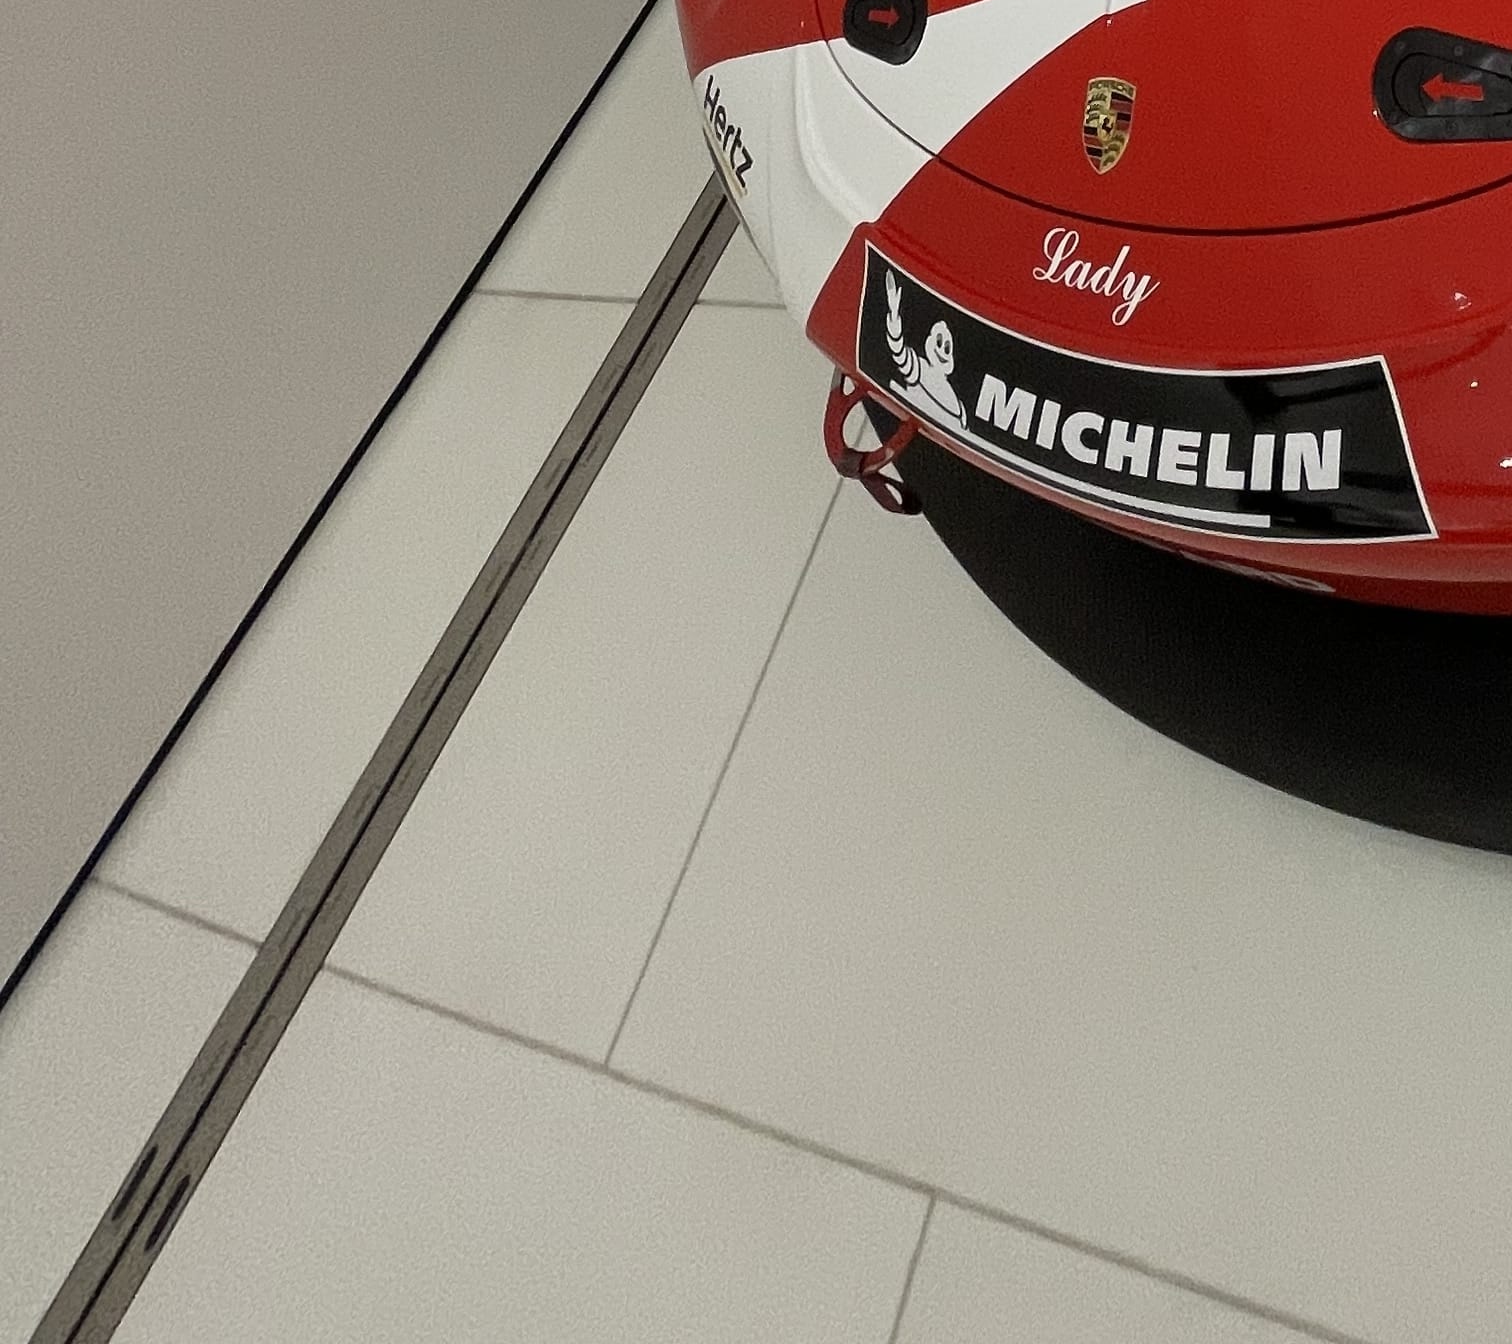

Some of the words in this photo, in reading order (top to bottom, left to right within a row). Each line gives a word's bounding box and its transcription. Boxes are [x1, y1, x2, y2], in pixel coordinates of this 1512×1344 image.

[703, 74, 754, 189] Hertz
[1032, 227, 1161, 327] Lady
[974, 372, 1343, 492] MICHELIN
